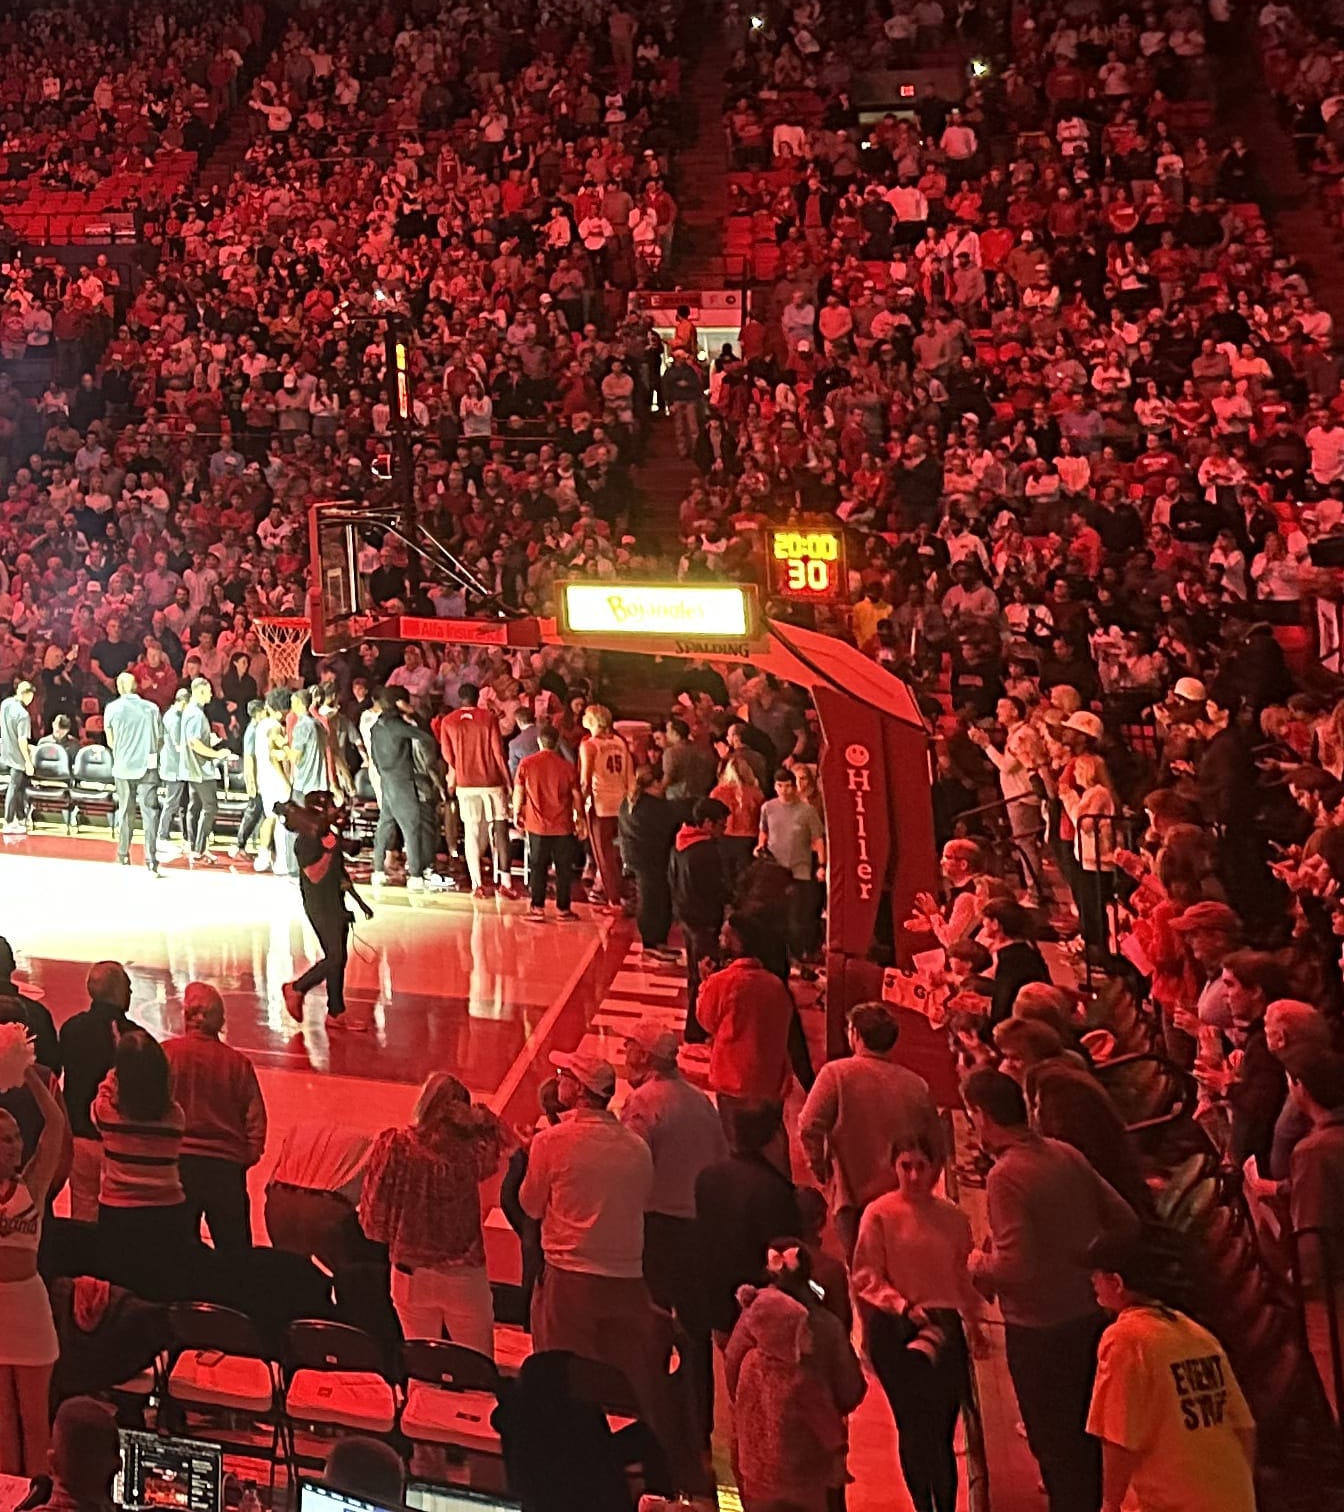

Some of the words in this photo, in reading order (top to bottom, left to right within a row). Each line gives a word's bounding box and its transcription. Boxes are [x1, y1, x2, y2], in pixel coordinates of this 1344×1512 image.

[773, 532, 838, 561] 20:00
[788, 559, 828, 590] 30
[675, 640, 750, 658] SPALDING
[606, 754, 622, 773] 45
[846, 768, 873, 900] Hiller
